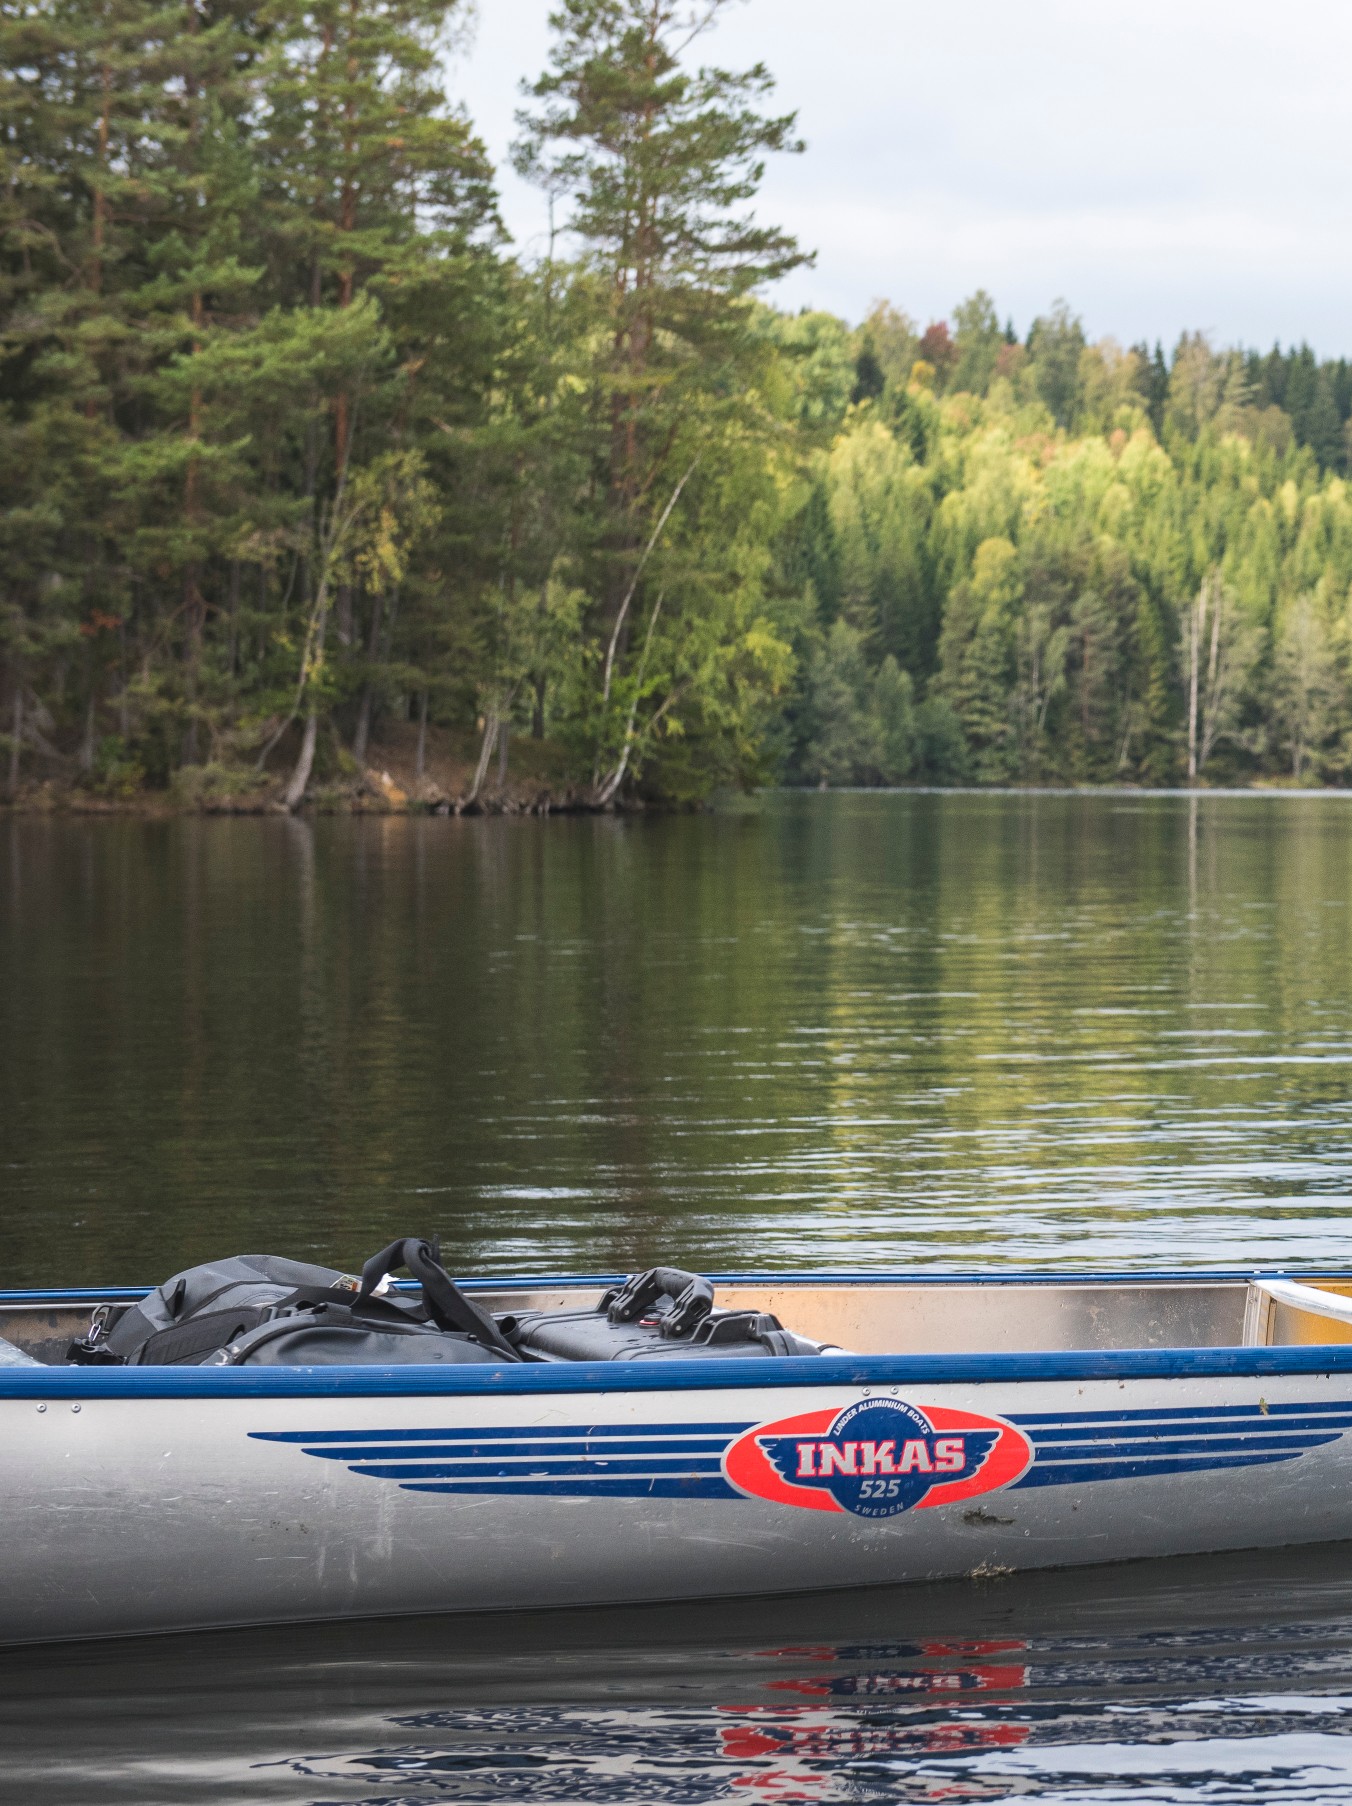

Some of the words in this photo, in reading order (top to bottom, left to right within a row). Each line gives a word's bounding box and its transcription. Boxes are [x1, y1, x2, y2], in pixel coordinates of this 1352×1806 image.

[833, 1408, 858, 1436] LINDER
[858, 1400, 908, 1413] ALUMINIUM
[907, 1408, 930, 1435] BOATS
[796, 1439, 966, 1477] INKAS
[858, 1479, 902, 1499] 525
[854, 1502, 904, 1516] SWEDEN
